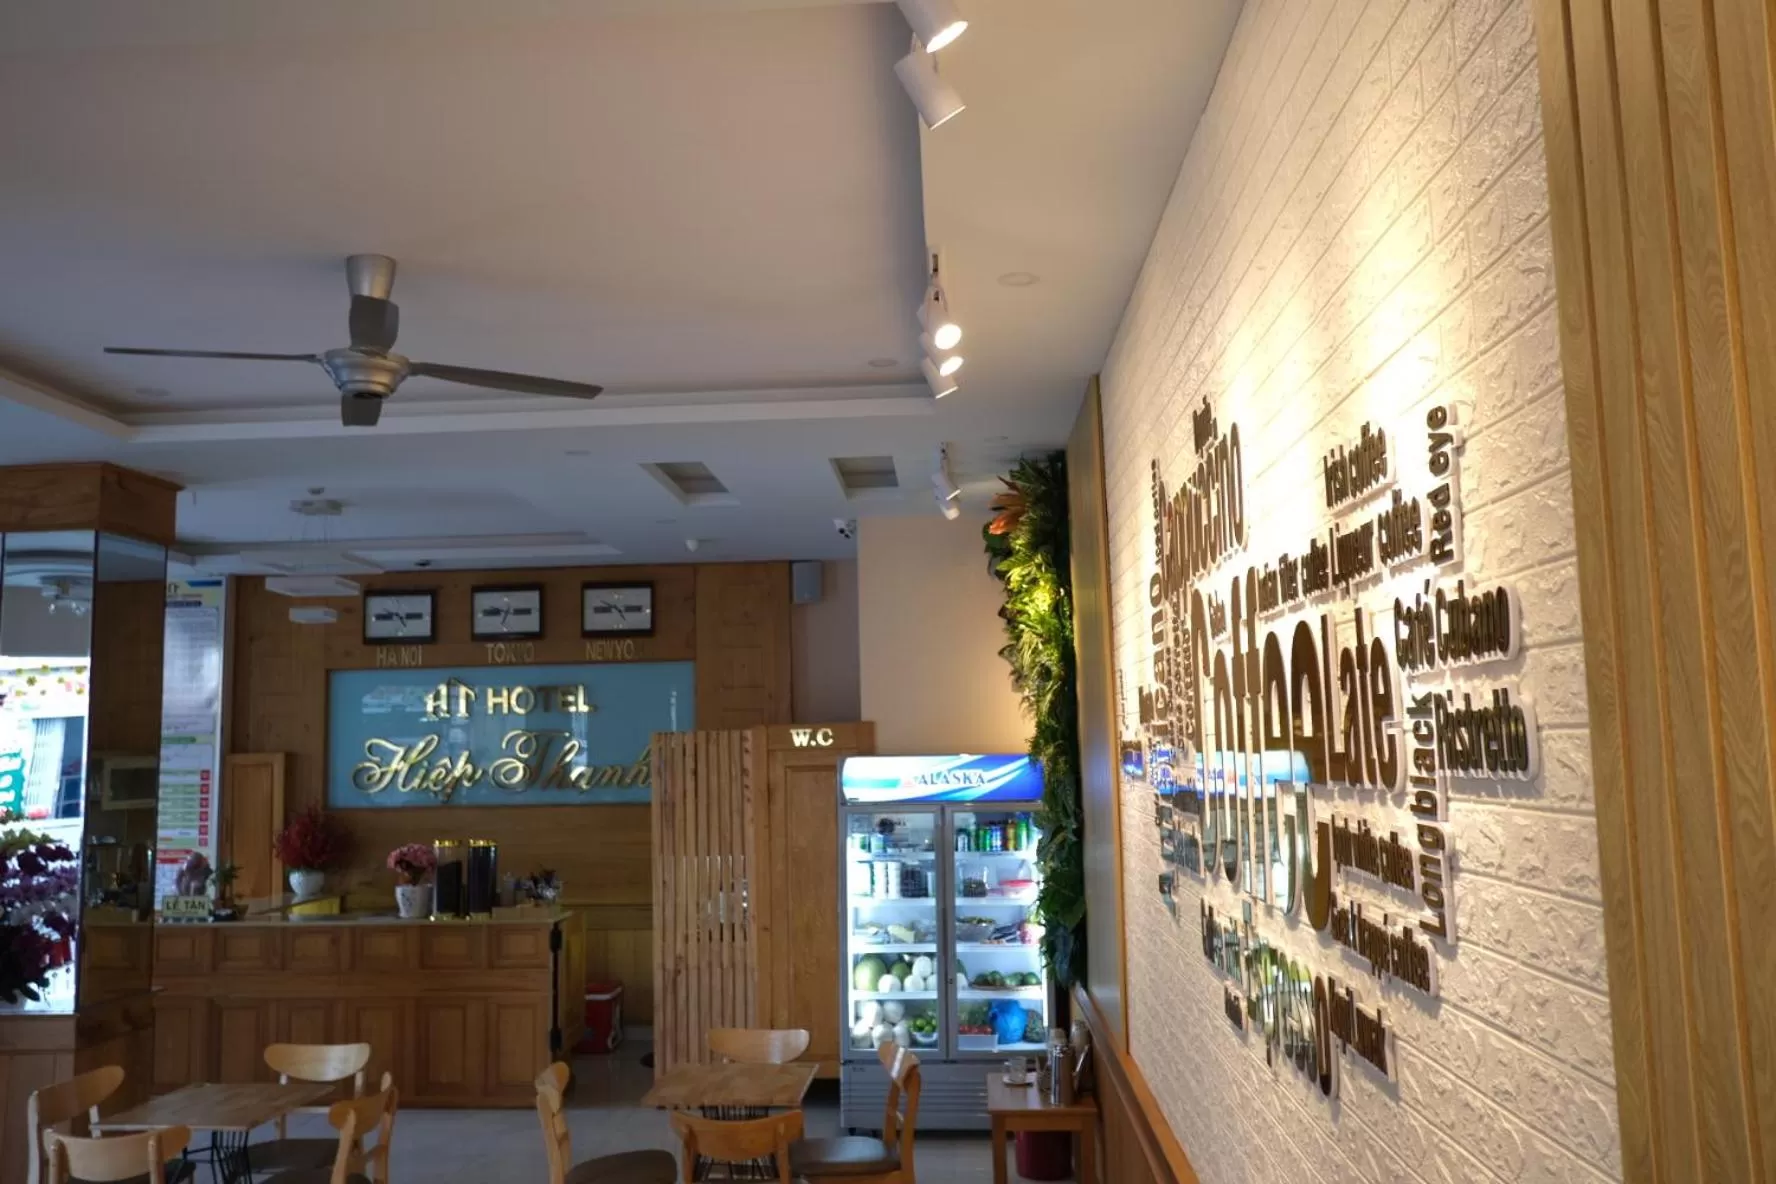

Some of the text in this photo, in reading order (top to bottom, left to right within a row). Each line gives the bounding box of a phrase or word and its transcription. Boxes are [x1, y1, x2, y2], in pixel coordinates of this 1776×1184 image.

[1323, 421, 1388, 508] Irish coffee
[1427, 405, 1455, 567] Red eye
[1159, 421, 1245, 610] Cappuccino
[1329, 488, 1423, 597] Liqueur coffee
[1301, 537, 1329, 598] coffee
[376, 644, 423, 666] HANOI
[1394, 578, 1510, 671] Café Cubano
[486, 685, 594, 714] HOTEL
[790, 728, 834, 747] W.C
[1320, 607, 1402, 790] Late
[1434, 687, 1529, 773] Ristretto
[918, 771, 985, 785] ALASKA
[1190, 565, 1332, 932] Coffee
[1406, 691, 1446, 937] Long black
[1378, 831, 1415, 891] coffee
[1390, 926, 1431, 993] coffee
